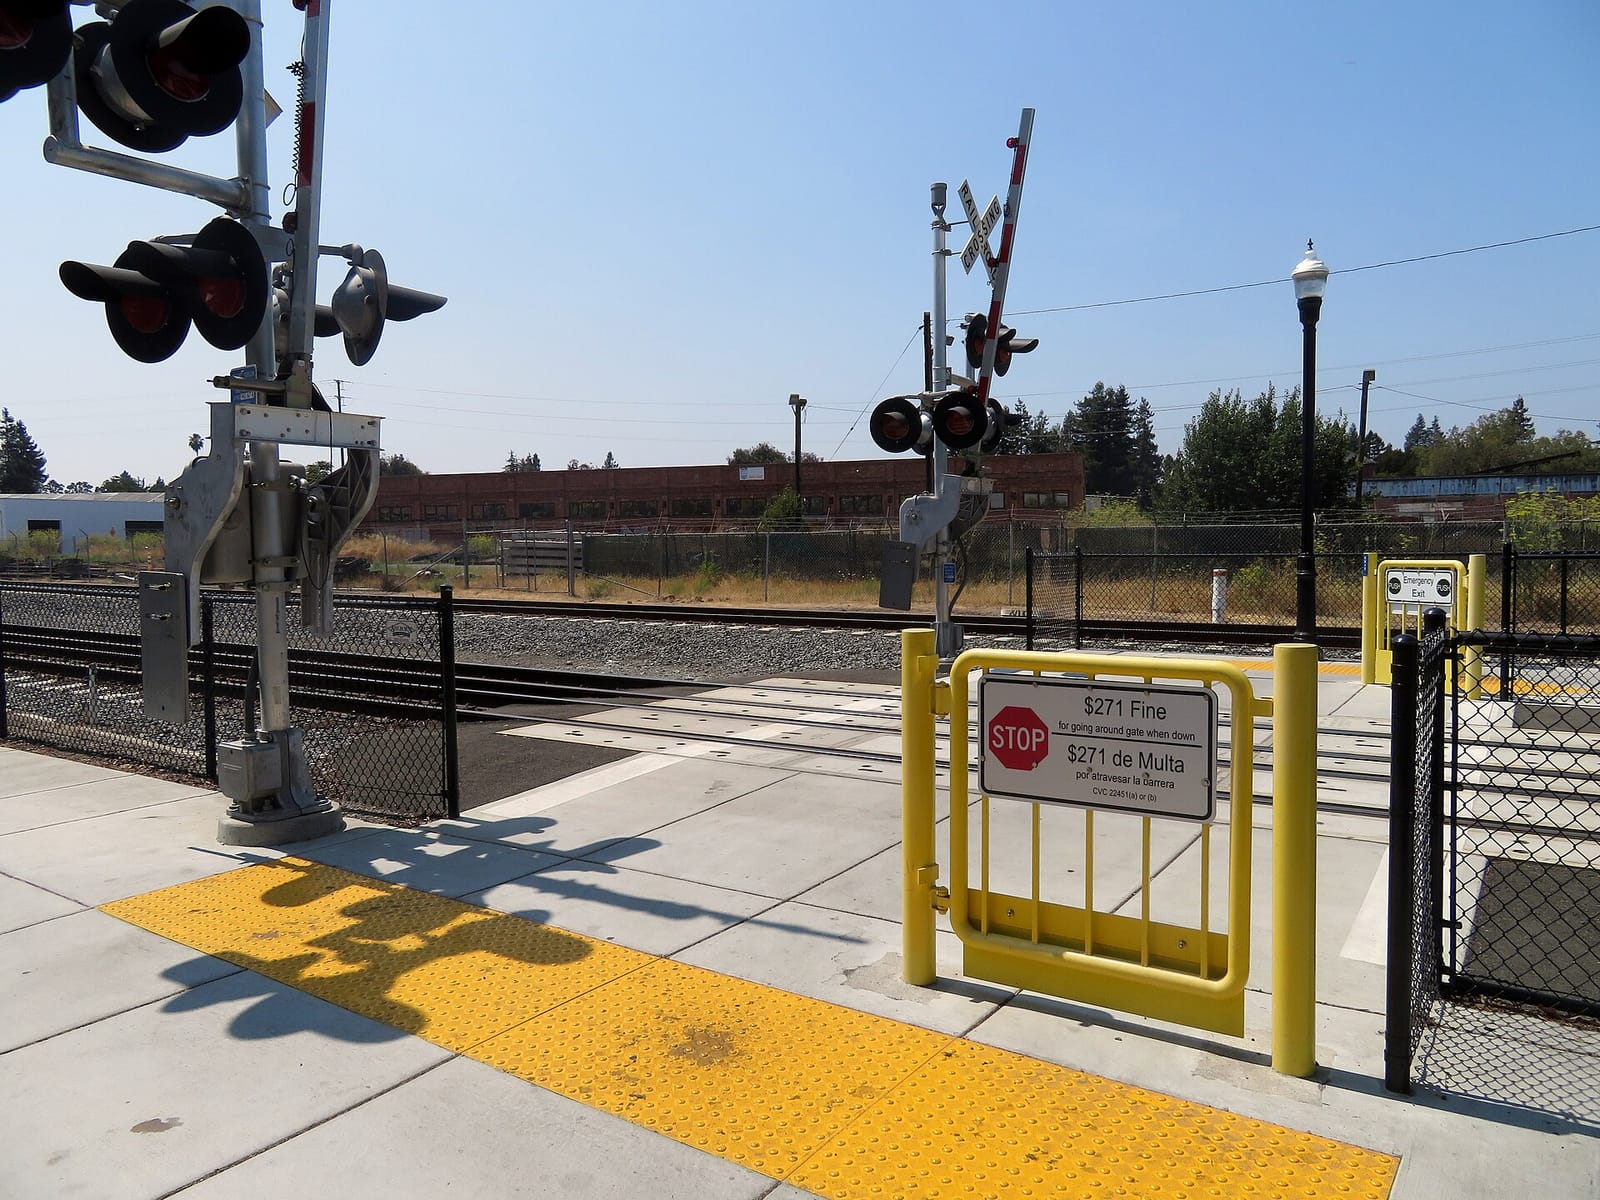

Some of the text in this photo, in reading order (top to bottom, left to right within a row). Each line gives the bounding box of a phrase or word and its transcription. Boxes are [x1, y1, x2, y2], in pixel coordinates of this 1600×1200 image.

[961, 184, 978, 228] RAIL
[963, 201, 1000, 269] CROSSING
[1403, 576, 1434, 587] Emergency
[1437, 584, 1451, 592] PUSH
[1411, 588, 1425, 597] Exit
[1084, 696, 1167, 720] $271 Fine
[991, 724, 1045, 752] STOP
[1058, 720, 1196, 741] for going around gate when down
[1067, 743, 1185, 773] $271 de Multa
[1076, 771, 1090, 780] por
[1091, 772, 1131, 784] atravesar
[1132, 775, 1141, 785] la
[1092, 786, 1157, 803] CVC 22451(a) or (b)
